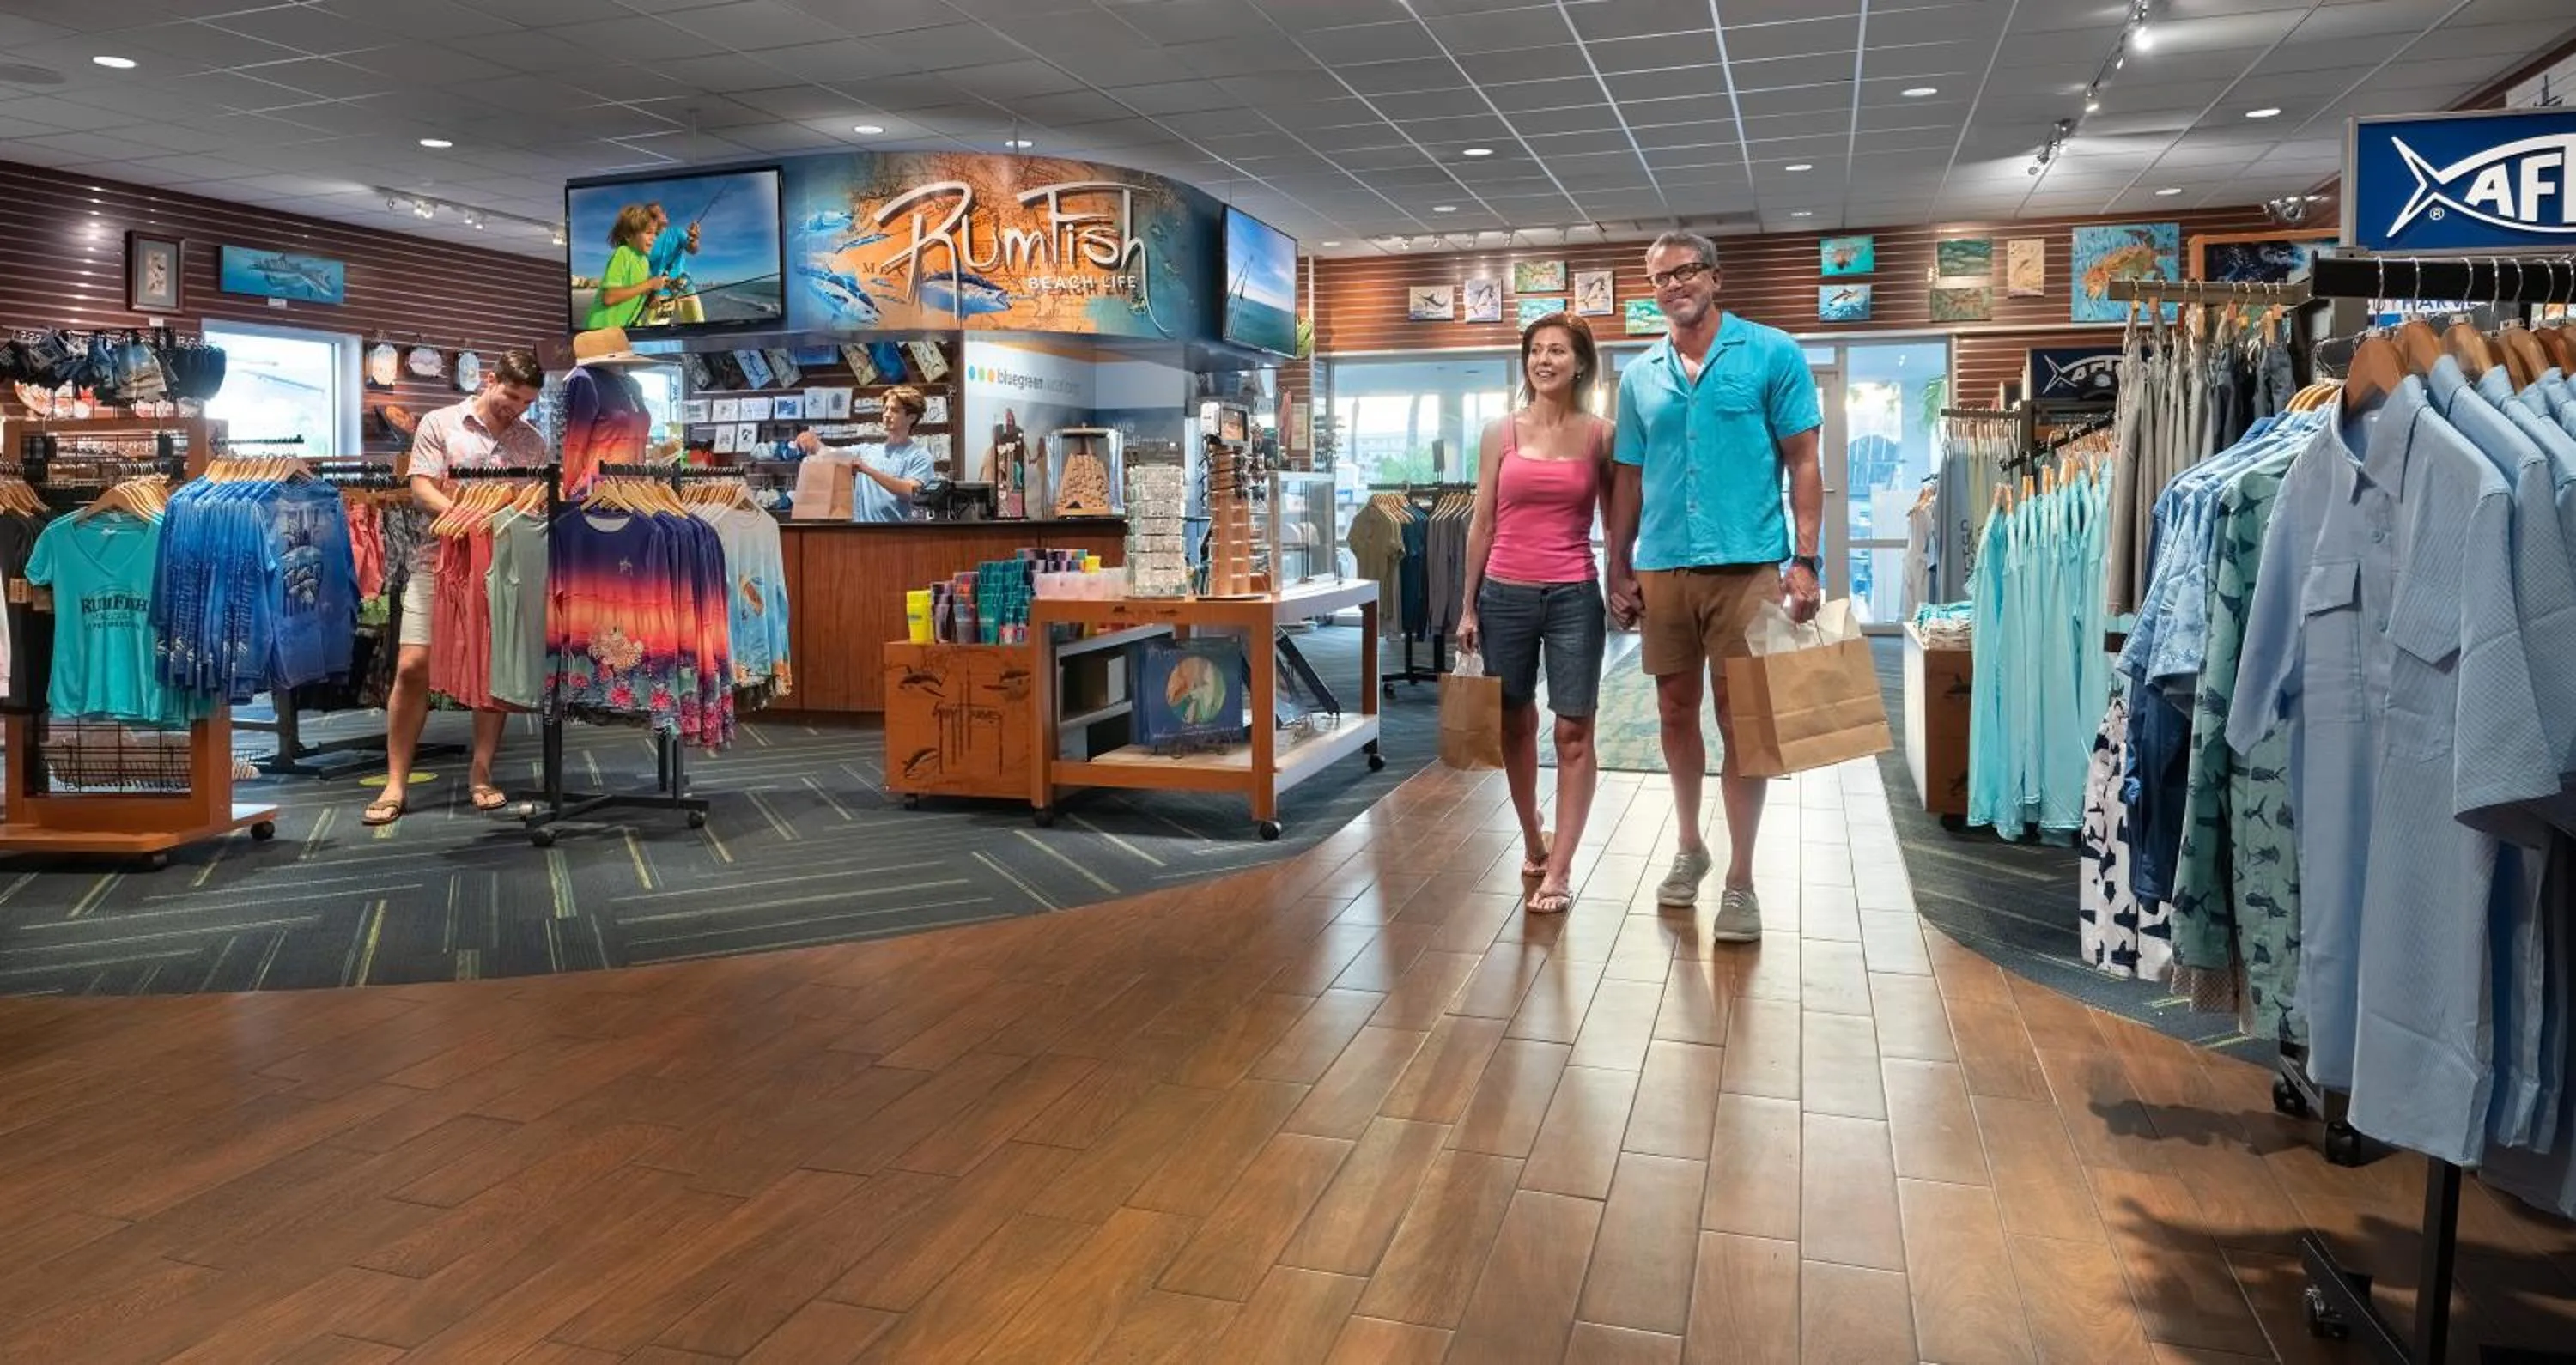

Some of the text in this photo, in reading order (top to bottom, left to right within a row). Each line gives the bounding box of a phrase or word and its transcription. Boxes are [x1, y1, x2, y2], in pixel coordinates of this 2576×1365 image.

[1028, 275, 1137, 290] BEACH LIFE
[997, 368, 1044, 391] bluegreen
